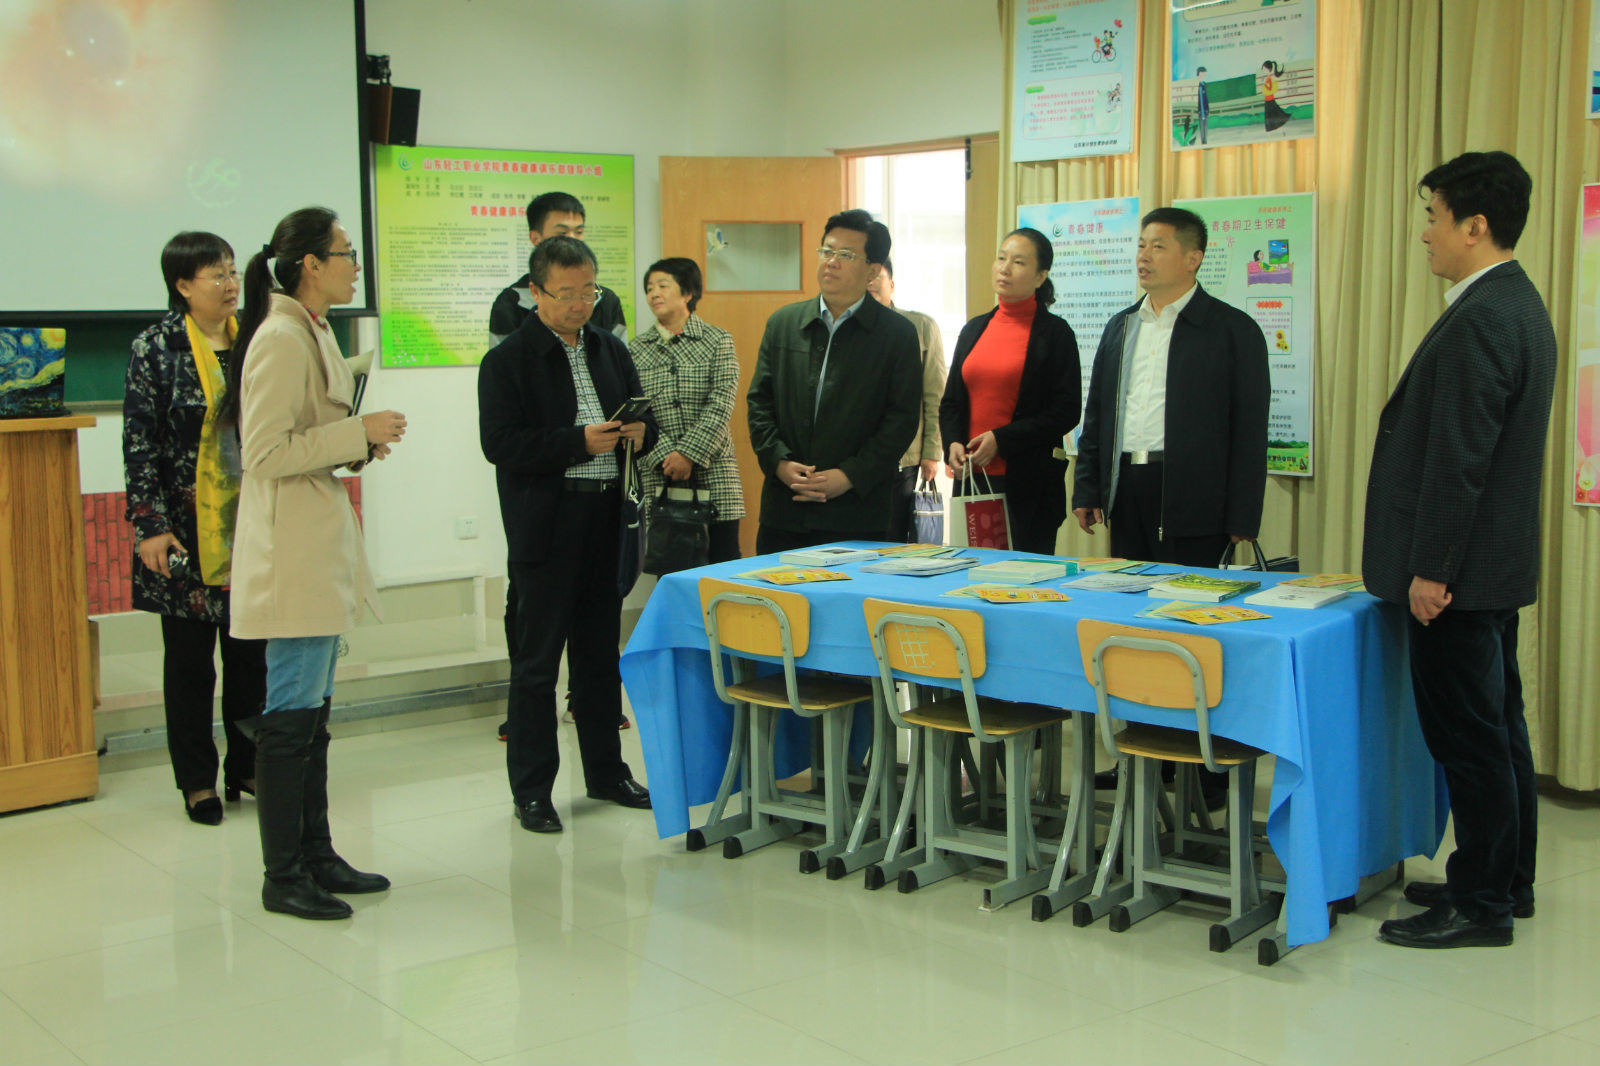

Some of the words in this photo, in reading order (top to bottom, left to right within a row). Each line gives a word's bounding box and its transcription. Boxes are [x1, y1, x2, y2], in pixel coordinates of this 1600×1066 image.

[1212, 217, 1286, 232] 青春期卫生保健
